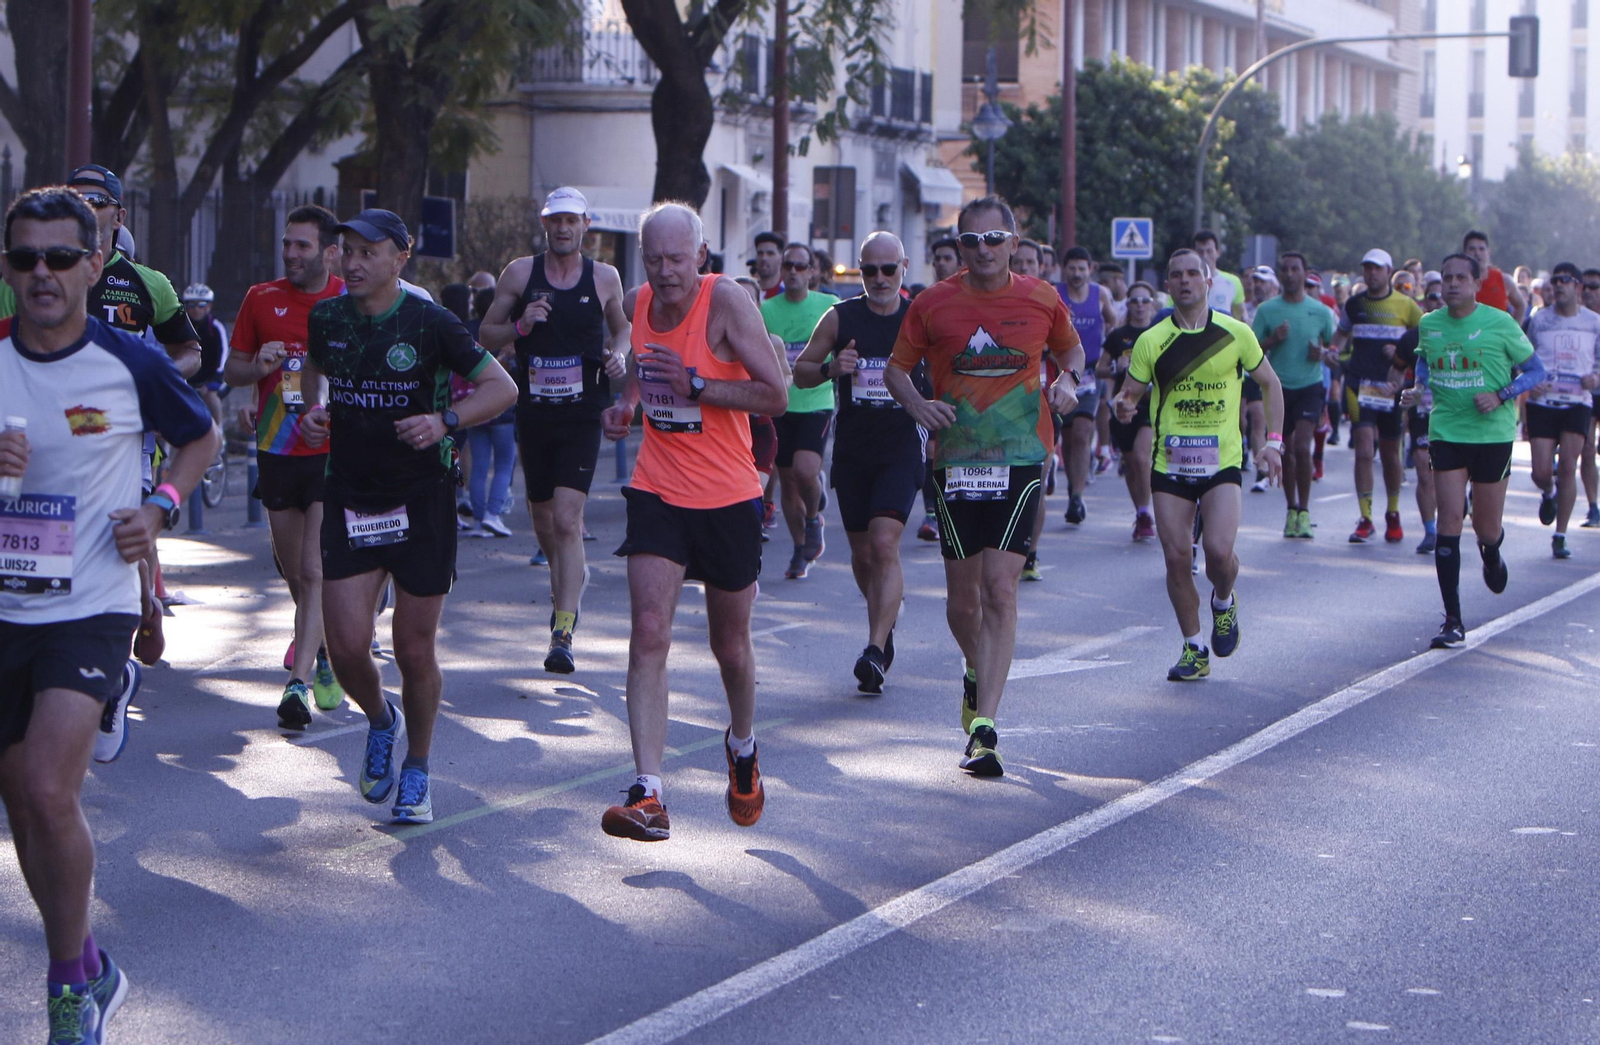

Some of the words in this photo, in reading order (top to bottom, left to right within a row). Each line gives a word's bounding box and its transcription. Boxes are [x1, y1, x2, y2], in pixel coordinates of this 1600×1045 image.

[105, 289, 139, 299] PAREDES
[101, 294, 142, 305] AVENTURA
[544, 359, 575, 367] ZURICH
[545, 376, 567, 385] 6652
[1444, 376, 1485, 389] Madrid
[361, 381, 420, 391] ATLETISMO
[540, 386, 573, 394] JORLUMAR
[1174, 383, 1191, 392] LOS
[332, 389, 409, 409] MONTIJO
[647, 393, 675, 406] 7181
[652, 409, 673, 419] JOHN
[1181, 438, 1212, 446] ZURICH
[962, 467, 993, 476] 10964
[947, 481, 975, 490] MANUEL
[977, 480, 1006, 489] BERNAL
[4, 500, 62, 516] ZURICH
[352, 518, 401, 534] FIGUEIREDO
[2, 534, 40, 551] 7813
